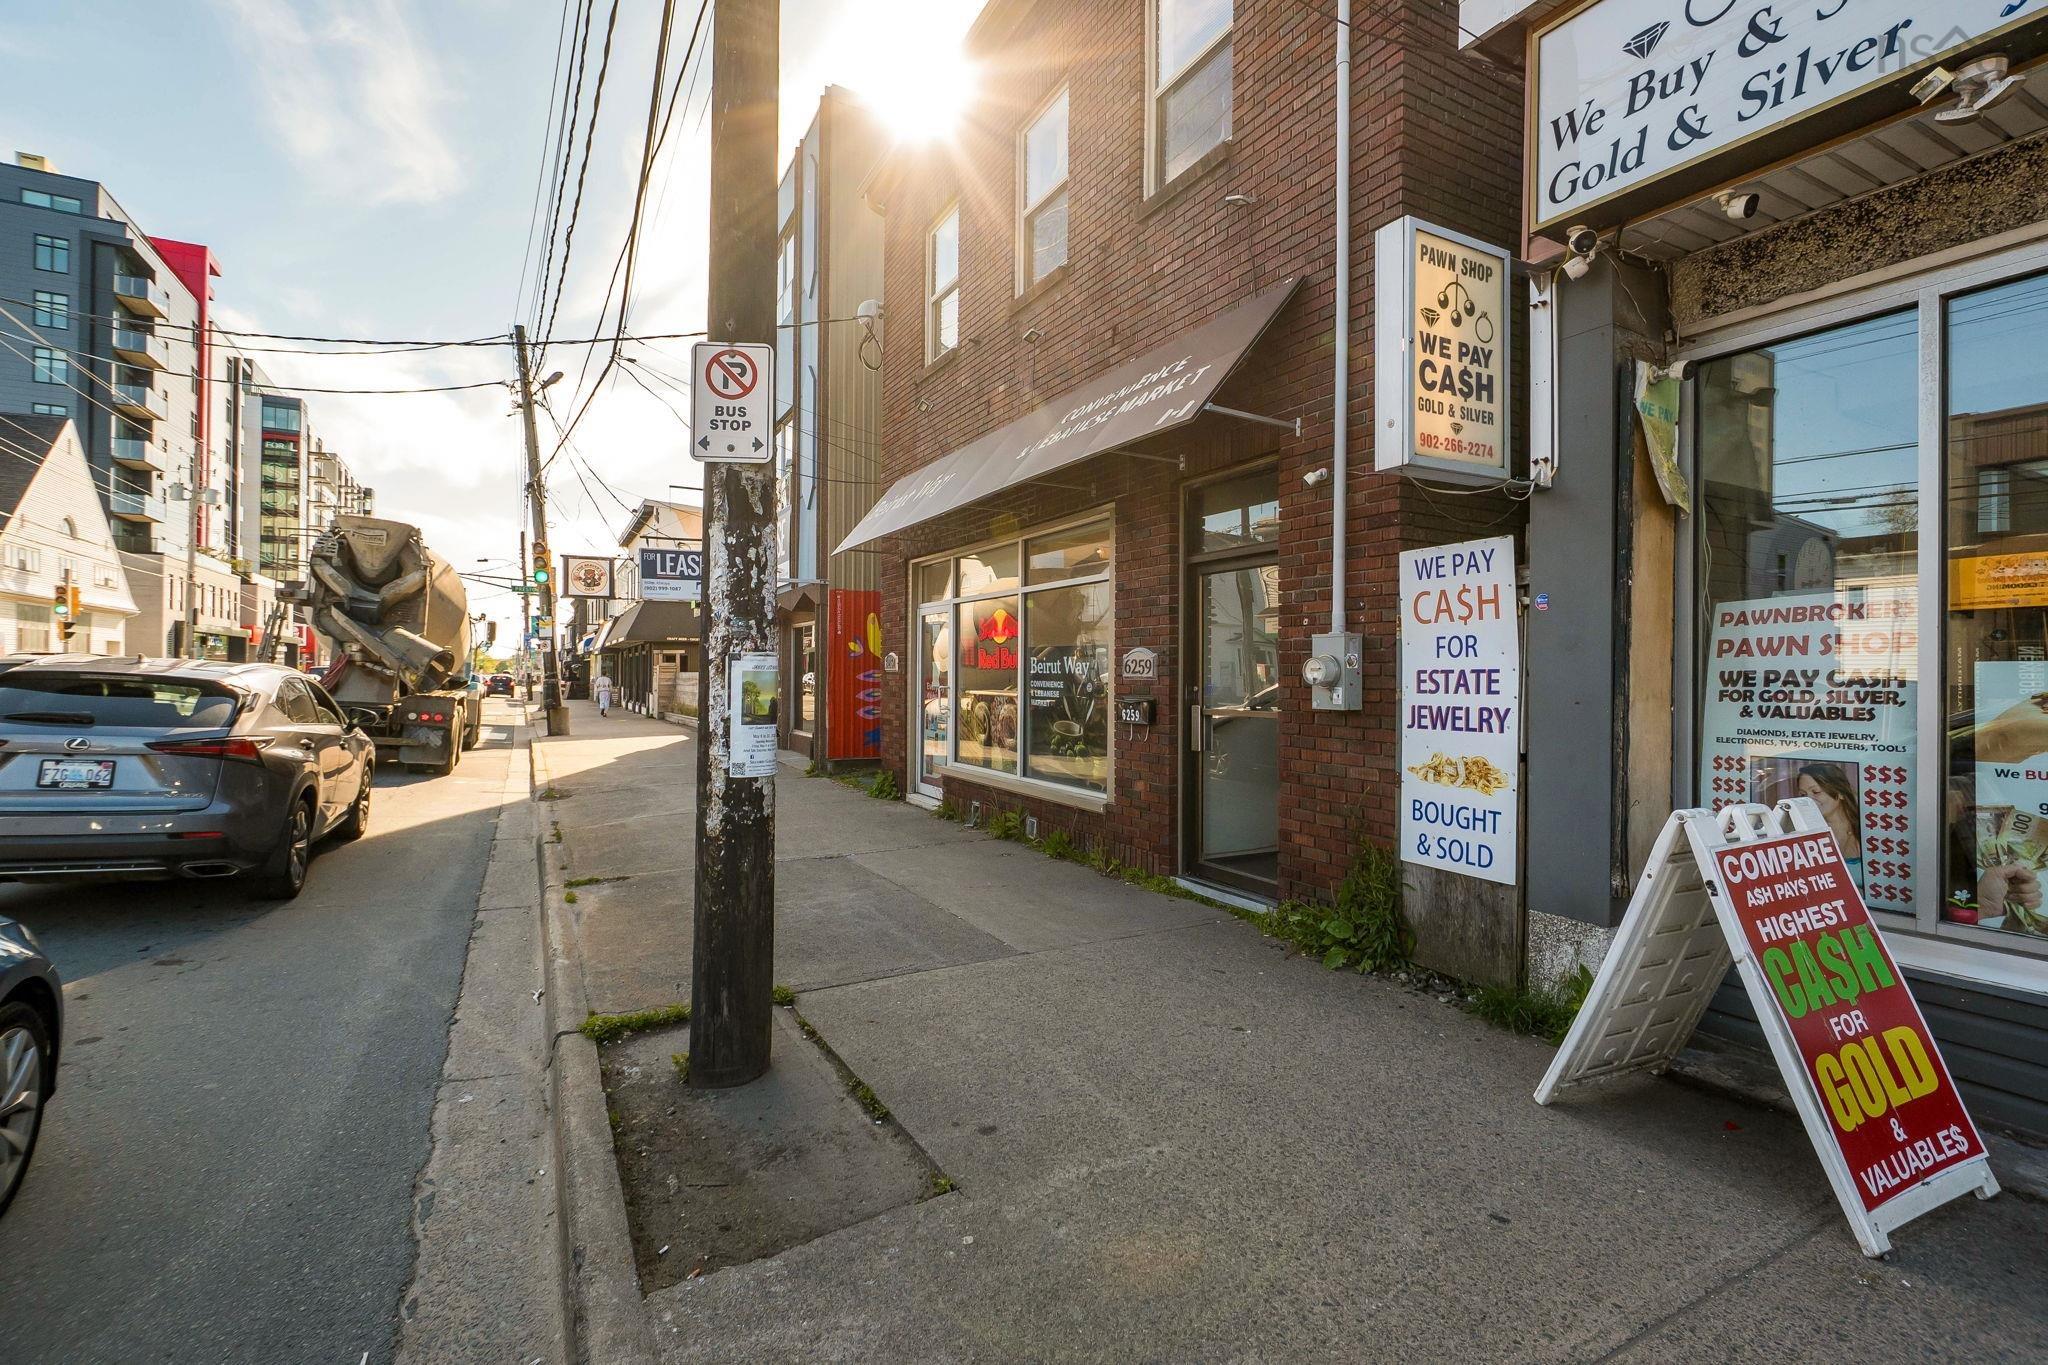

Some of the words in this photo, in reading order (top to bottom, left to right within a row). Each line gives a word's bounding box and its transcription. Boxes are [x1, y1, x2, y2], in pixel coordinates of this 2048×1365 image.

[1550, 98, 1606, 152] We
[1623, 49, 1716, 119] Buy
[1737, 5, 1789, 58] &
[1549, 124, 1648, 204] Gold
[1667, 104, 1713, 151] &
[1737, 18, 1913, 122] Silver
[1420, 243, 1456, 273] PAWN
[1461, 257, 1493, 283] SHOP
[1419, 330, 1452, 360] WE
[1458, 341, 1493, 369] PAY
[1061, 355, 1193, 424] CONVENIENCE
[1114, 364, 1212, 417] MARKET
[1419, 359, 1494, 404] CA$H
[715, 405, 747, 418] BUS
[1418, 396, 1444, 416] GOLD
[1448, 404, 1456, 418] &
[1460, 406, 1494, 426] SILVER
[709, 418, 752, 432] STOP
[265, 441, 285, 449] FOR
[1420, 432, 1494, 458] 902-266-2274
[643, 552, 656, 561] FOR
[1414, 555, 1447, 581] WE
[1452, 548, 1495, 577] PAY
[1413, 583, 1500, 626] CA$H
[1719, 602, 1914, 628] PAWNBROKERS
[1436, 635, 1478, 659] FOR
[1716, 635, 1810, 658] PAWN
[1819, 631, 1916, 657] SHOP
[1030, 656, 1061, 674] Beirut
[1063, 656, 1090, 680] Way
[1124, 658, 1152, 675] 6259
[1719, 670, 1757, 688] WE
[1763, 669, 1819, 688] PAY
[1826, 668, 1907, 689] CASH
[1030, 680, 1064, 689] CONVENIENCE
[1035, 690, 1060, 698] LEBANESE
[1416, 669, 1500, 695] ESTATE
[1718, 690, 1754, 702] FOR
[1759, 690, 1821, 705] GOLD,
[1826, 690, 1907, 708] SILVER,
[1121, 709, 1140, 722] 6259
[1407, 704, 1511, 734] JEWELRY
[1739, 705, 1753, 718] &
[1757, 705, 1876, 721] VALUABLES
[1716, 737, 1777, 747] ELECTRONICS,
[1779, 739, 1800, 749] TV'S,
[1803, 741, 1868, 752] COMPUTERS,
[1871, 744, 1907, 753] TOOLS
[1736, 728, 1789, 738] DIAMONDS,
[1791, 730, 1826, 739] ESTATE
[42, 768, 69, 782] FZG
[86, 769, 111, 782] 062
[1713, 755, 1746, 773] $$$
[1864, 765, 1907, 785] $$$
[1994, 768, 2020, 780] We
[1712, 776, 1746, 794] $$$
[1864, 789, 1908, 809] $$$
[1412, 799, 1501, 834] BOUGHT
[1865, 812, 1909, 832] $$$
[2011, 813, 2032, 835] 100
[1417, 834, 1431, 857] &
[1437, 836, 1493, 868] SOLD
[1866, 836, 1910, 857] $$$
[1723, 837, 1838, 884] COMPARE
[1867, 859, 1911, 880] $$$
[1746, 886, 1775, 908] A$H
[1808, 872, 1837, 892] THE
[1869, 882, 1912, 904] $$$
[1756, 900, 1848, 943] HIGHEST
[1762, 924, 1896, 1018] CA$H
[1829, 1009, 1868, 1041] FOR
[1815, 1025, 1939, 1133] GOLD
[1890, 1117, 1907, 1142] &
[1860, 1125, 1969, 1197] VALUABLE$
